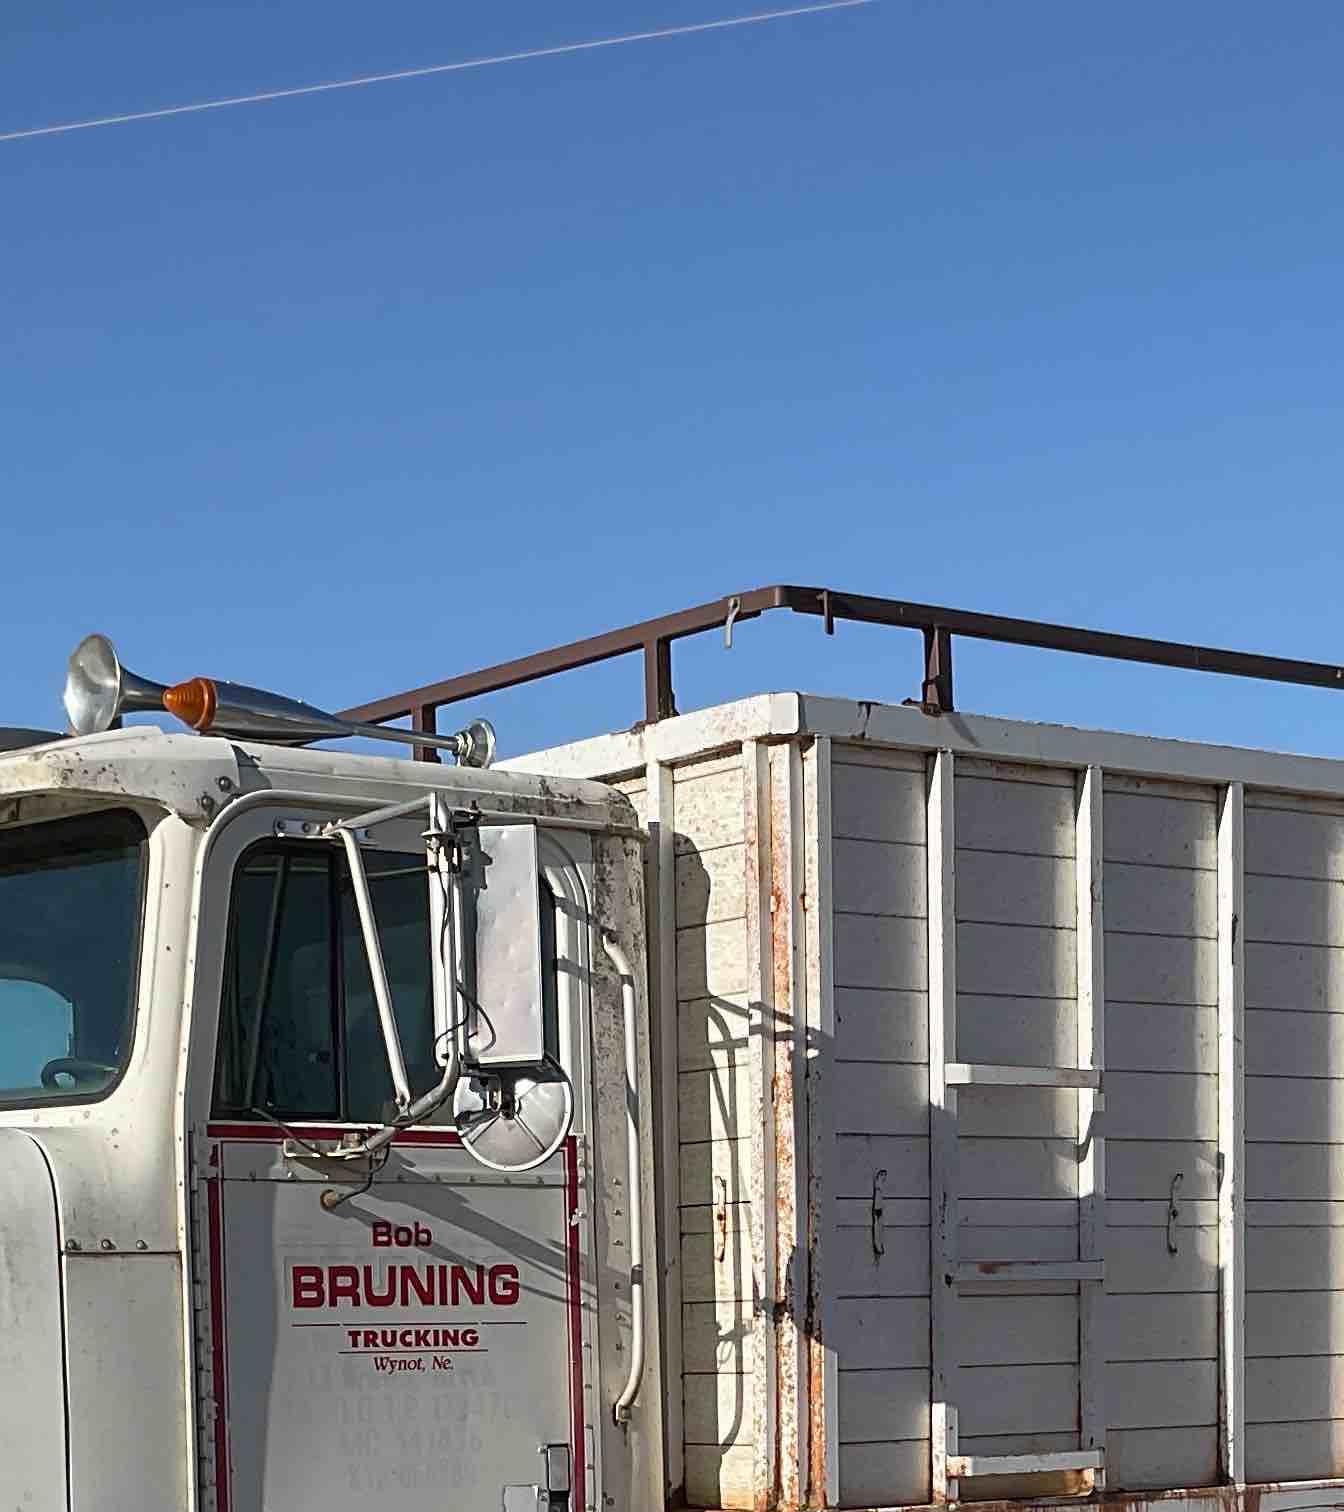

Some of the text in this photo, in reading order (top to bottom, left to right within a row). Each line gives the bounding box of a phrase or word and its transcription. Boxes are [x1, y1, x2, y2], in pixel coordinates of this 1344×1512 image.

[371, 1220, 433, 1248] Bob
[293, 1265, 519, 1307] BRUNING
[348, 1329, 479, 1347] TRUCKING
[374, 1356, 426, 1375] Wynot,
